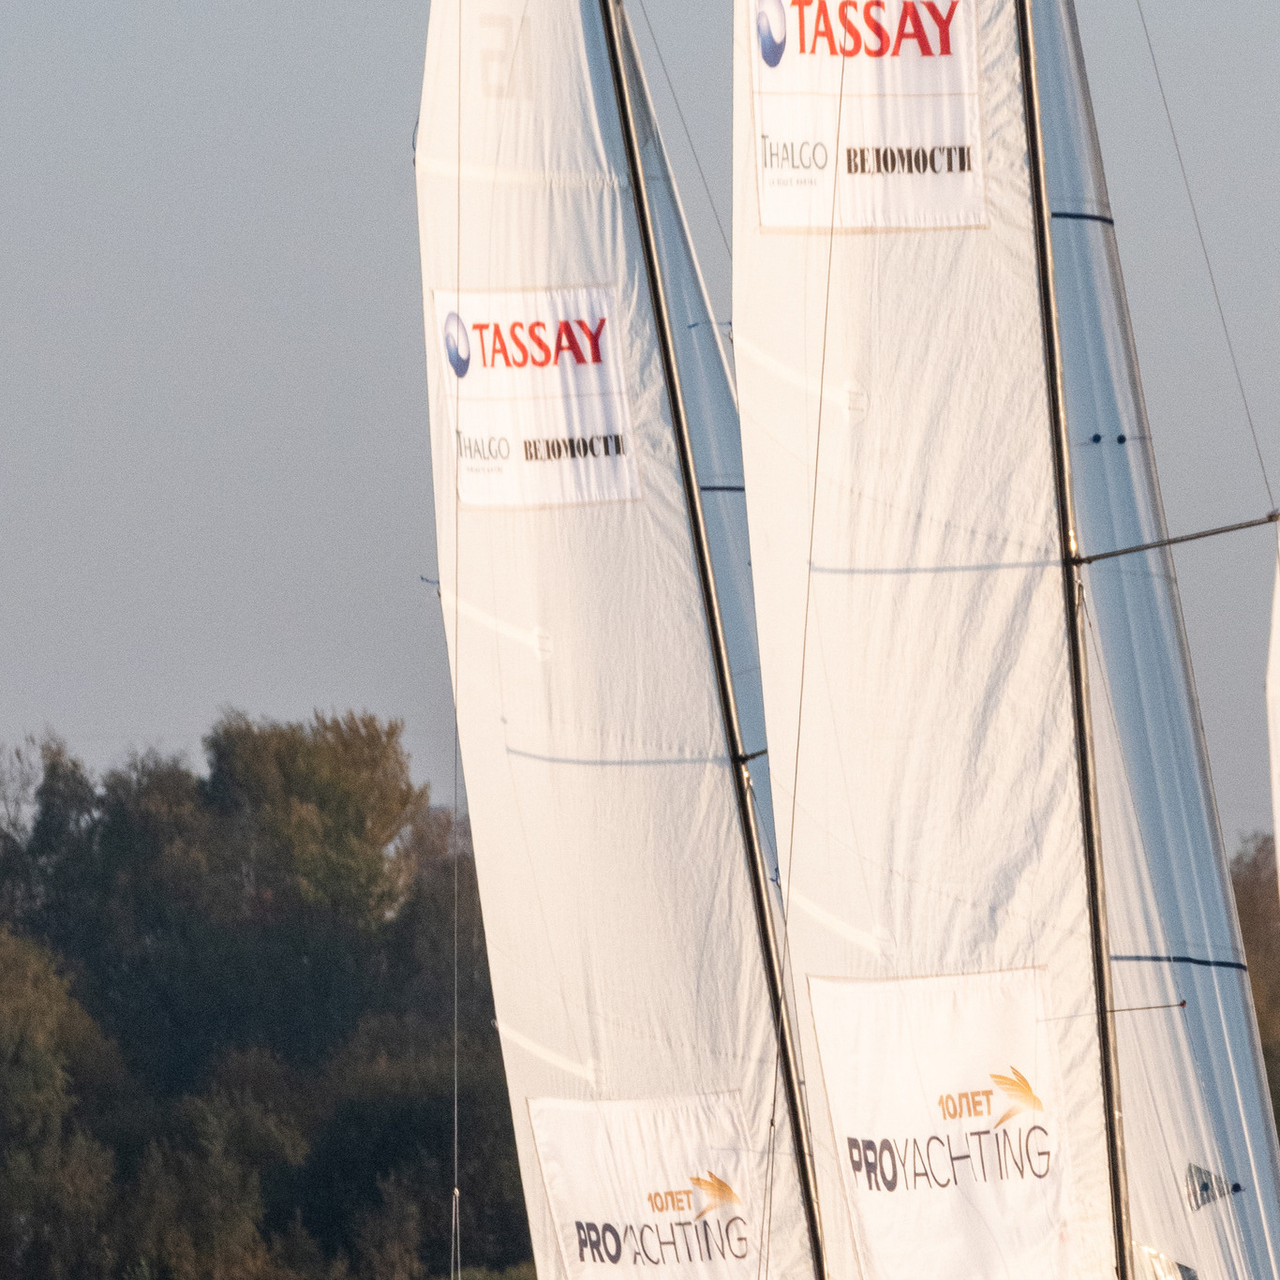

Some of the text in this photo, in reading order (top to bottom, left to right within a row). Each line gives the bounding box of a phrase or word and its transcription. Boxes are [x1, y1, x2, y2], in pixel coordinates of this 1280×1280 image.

[761, 134, 828, 169] THALGO
[846, 145, 972, 176] ВЕДОМОСТИ
[472, 318, 606, 368] TASSAY
[847, 1125, 1051, 1193] PROYACHTING
